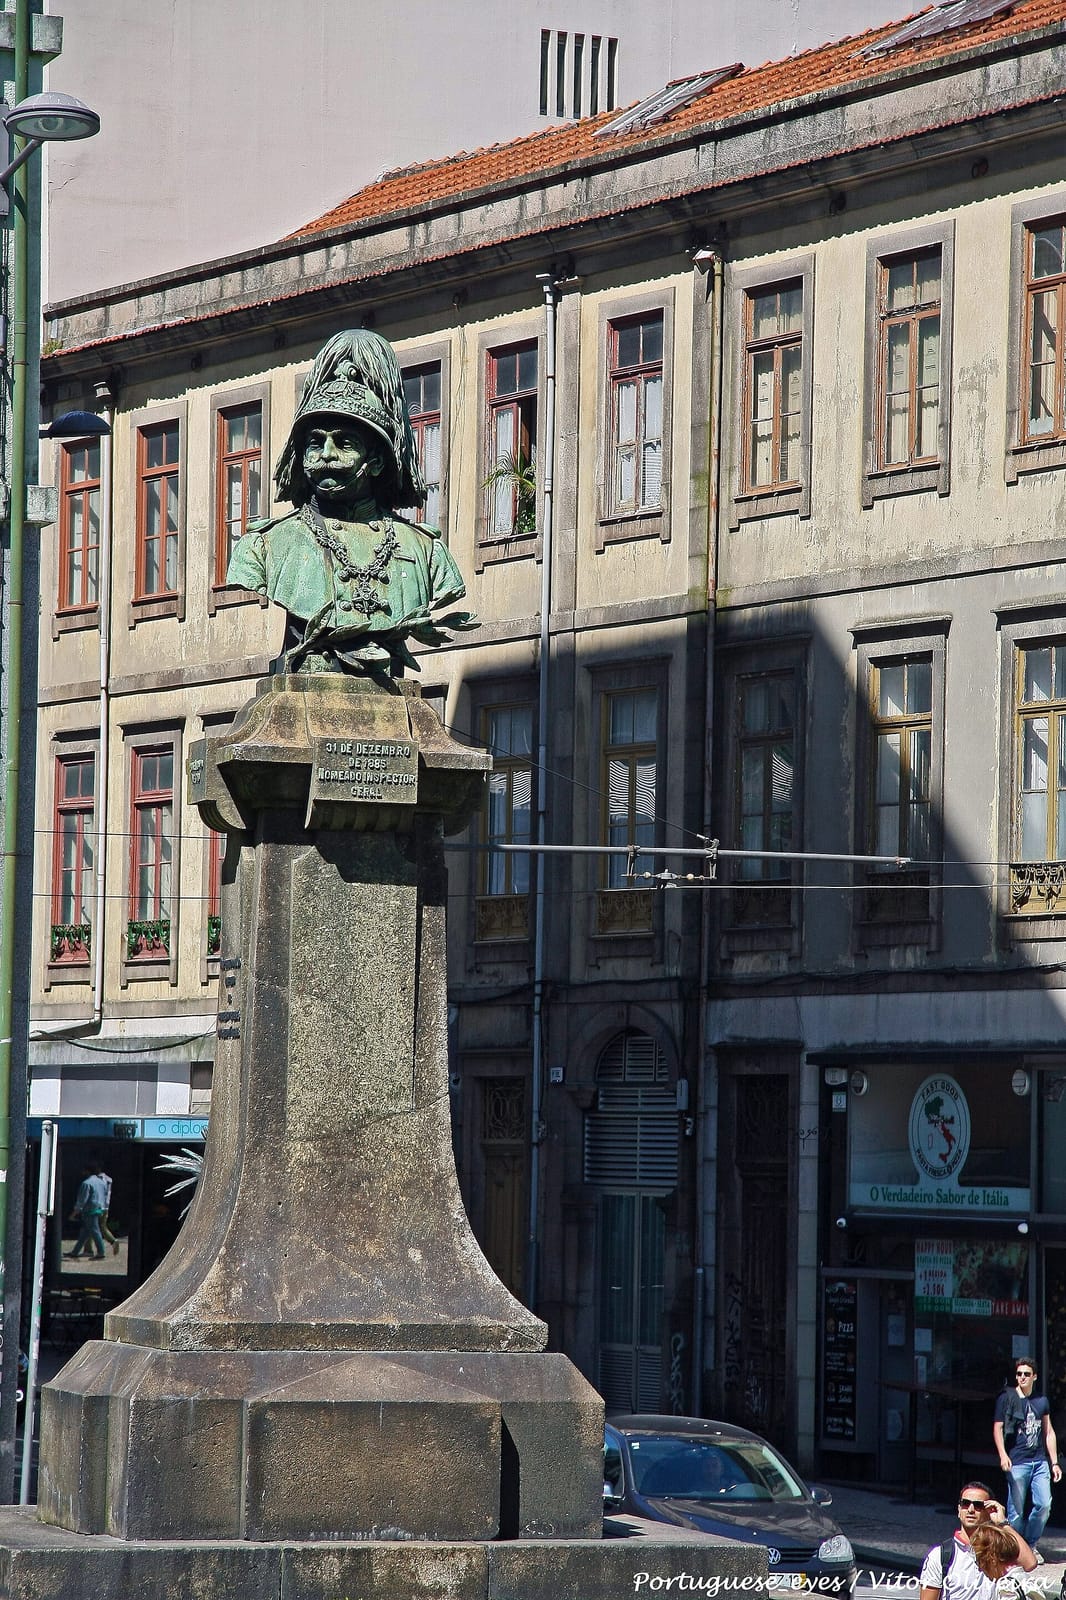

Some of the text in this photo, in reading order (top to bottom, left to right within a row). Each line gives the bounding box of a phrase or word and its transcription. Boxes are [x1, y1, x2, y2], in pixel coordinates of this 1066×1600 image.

[326, 742, 411, 757] 31 DE DEZEMBRO
[349, 757, 362, 769] DE
[318, 767, 416, 785] NOMEADO INSPECTOR
[351, 786, 383, 798] GERAL
[159, 1120, 208, 1137] o diplo
[869, 1186, 1010, 1206] O Verdadeiro Sabor de Itália
